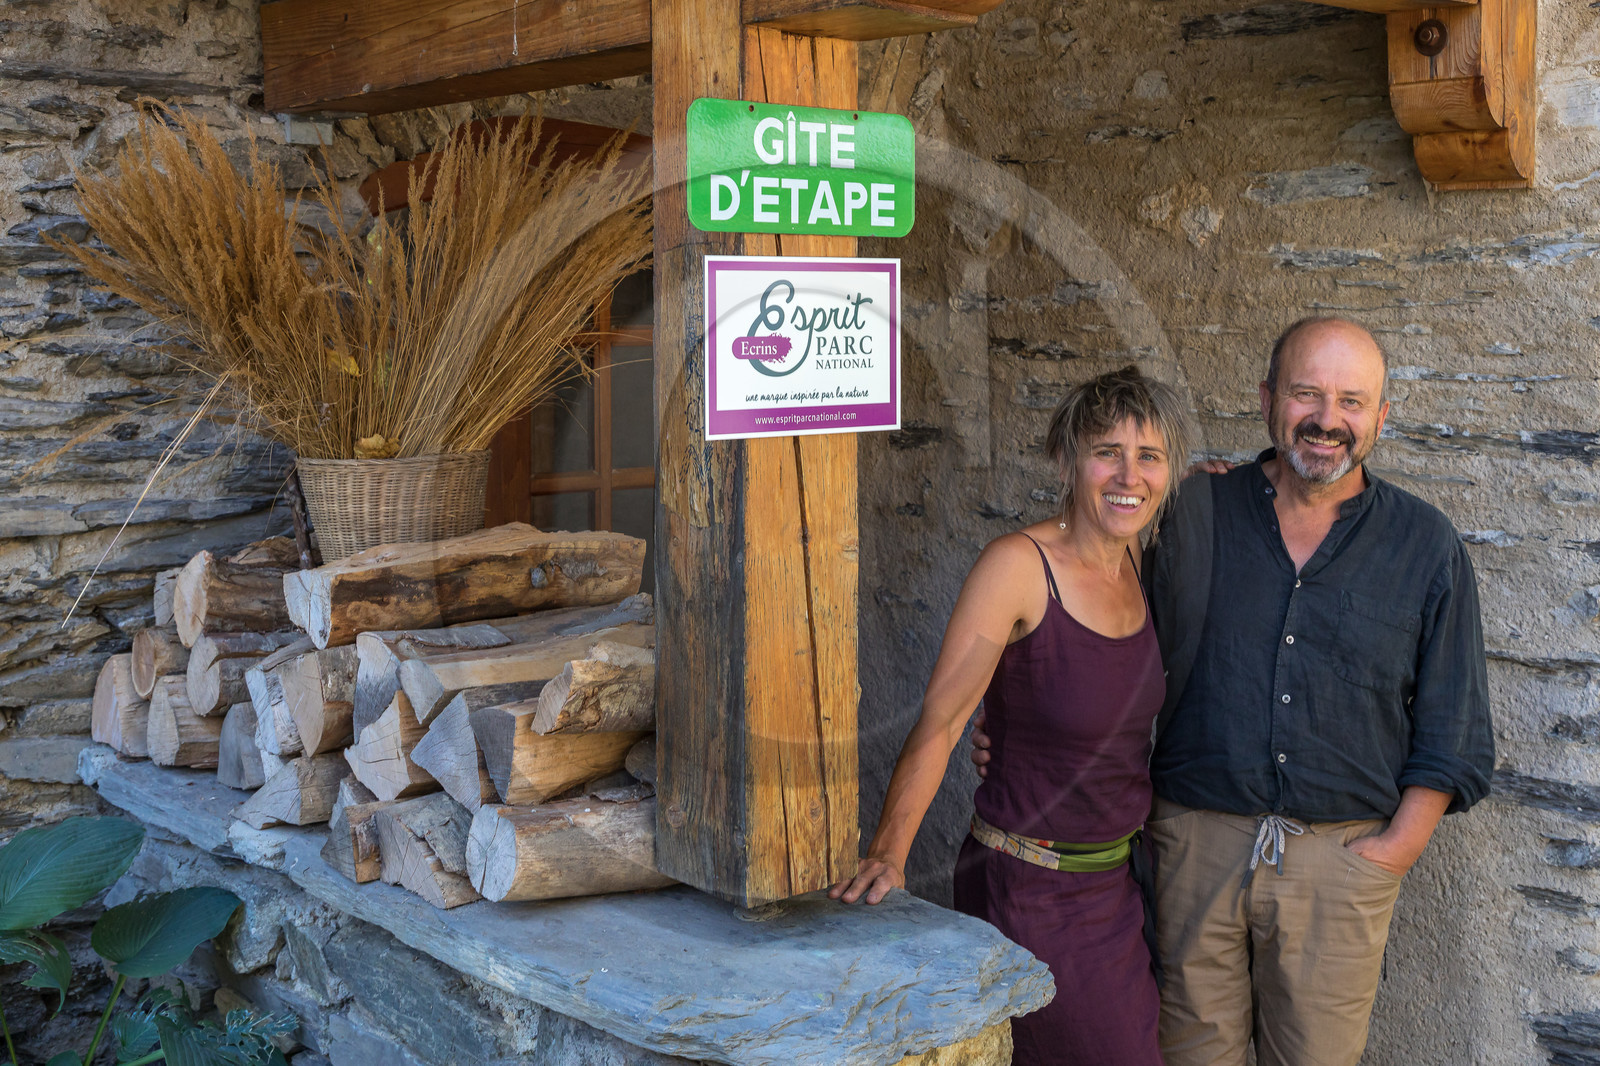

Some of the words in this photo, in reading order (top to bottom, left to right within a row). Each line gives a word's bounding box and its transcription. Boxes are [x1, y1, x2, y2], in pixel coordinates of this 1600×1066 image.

[753, 111, 855, 169] GÎTE
[710, 170, 895, 227] D'ETAPE
[746, 279, 873, 377] Esprit
[741, 341, 778, 356] Ecrins
[816, 335, 873, 355] PARC
[816, 358, 874, 370] NATIONAL
[745, 394, 759, 402] une
[760, 392, 789, 404] marque
[791, 390, 820, 404] inspirée
[821, 391, 835, 402] par
[835, 386, 844, 398] la
[845, 386, 869, 398] nature
[754, 411, 857, 425] www.espritparcnational.com
